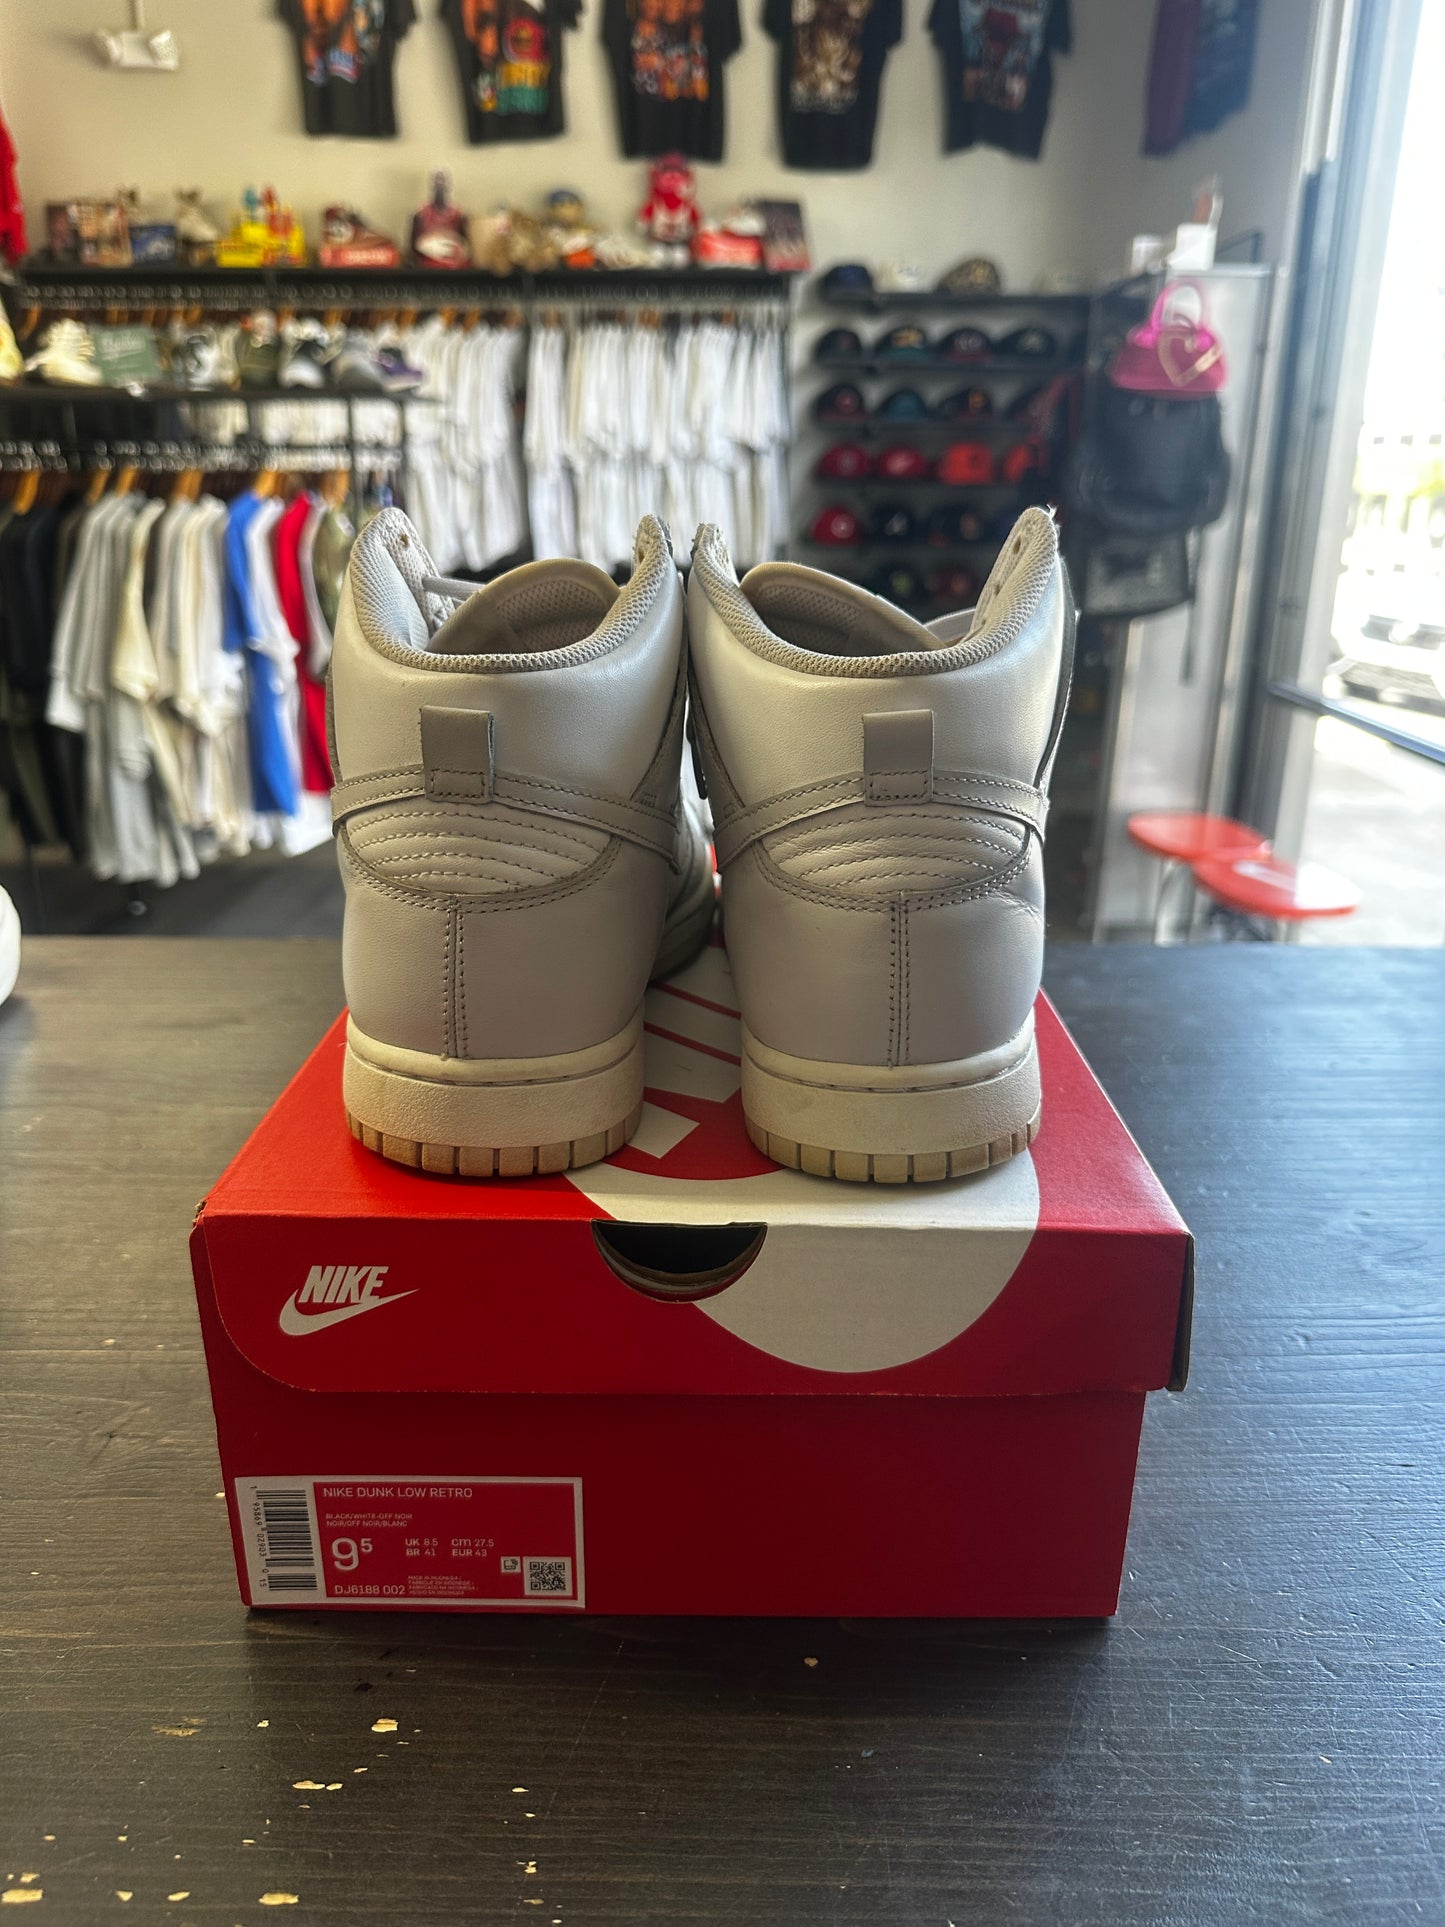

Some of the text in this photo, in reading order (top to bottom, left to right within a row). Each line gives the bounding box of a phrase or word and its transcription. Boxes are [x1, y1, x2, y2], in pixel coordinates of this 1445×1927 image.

[298, 1265, 389, 1304] NIKE
[323, 1487, 473, 1498] NIKE DUNK LOW RETRO
[405, 1538, 439, 1546] UK 8.5
[474, 1538, 495, 1547] 27.5
[406, 1548, 436, 1556] BR 41
[452, 1548, 488, 1557] EUR 43
[383, 1584, 405, 1595] 002
